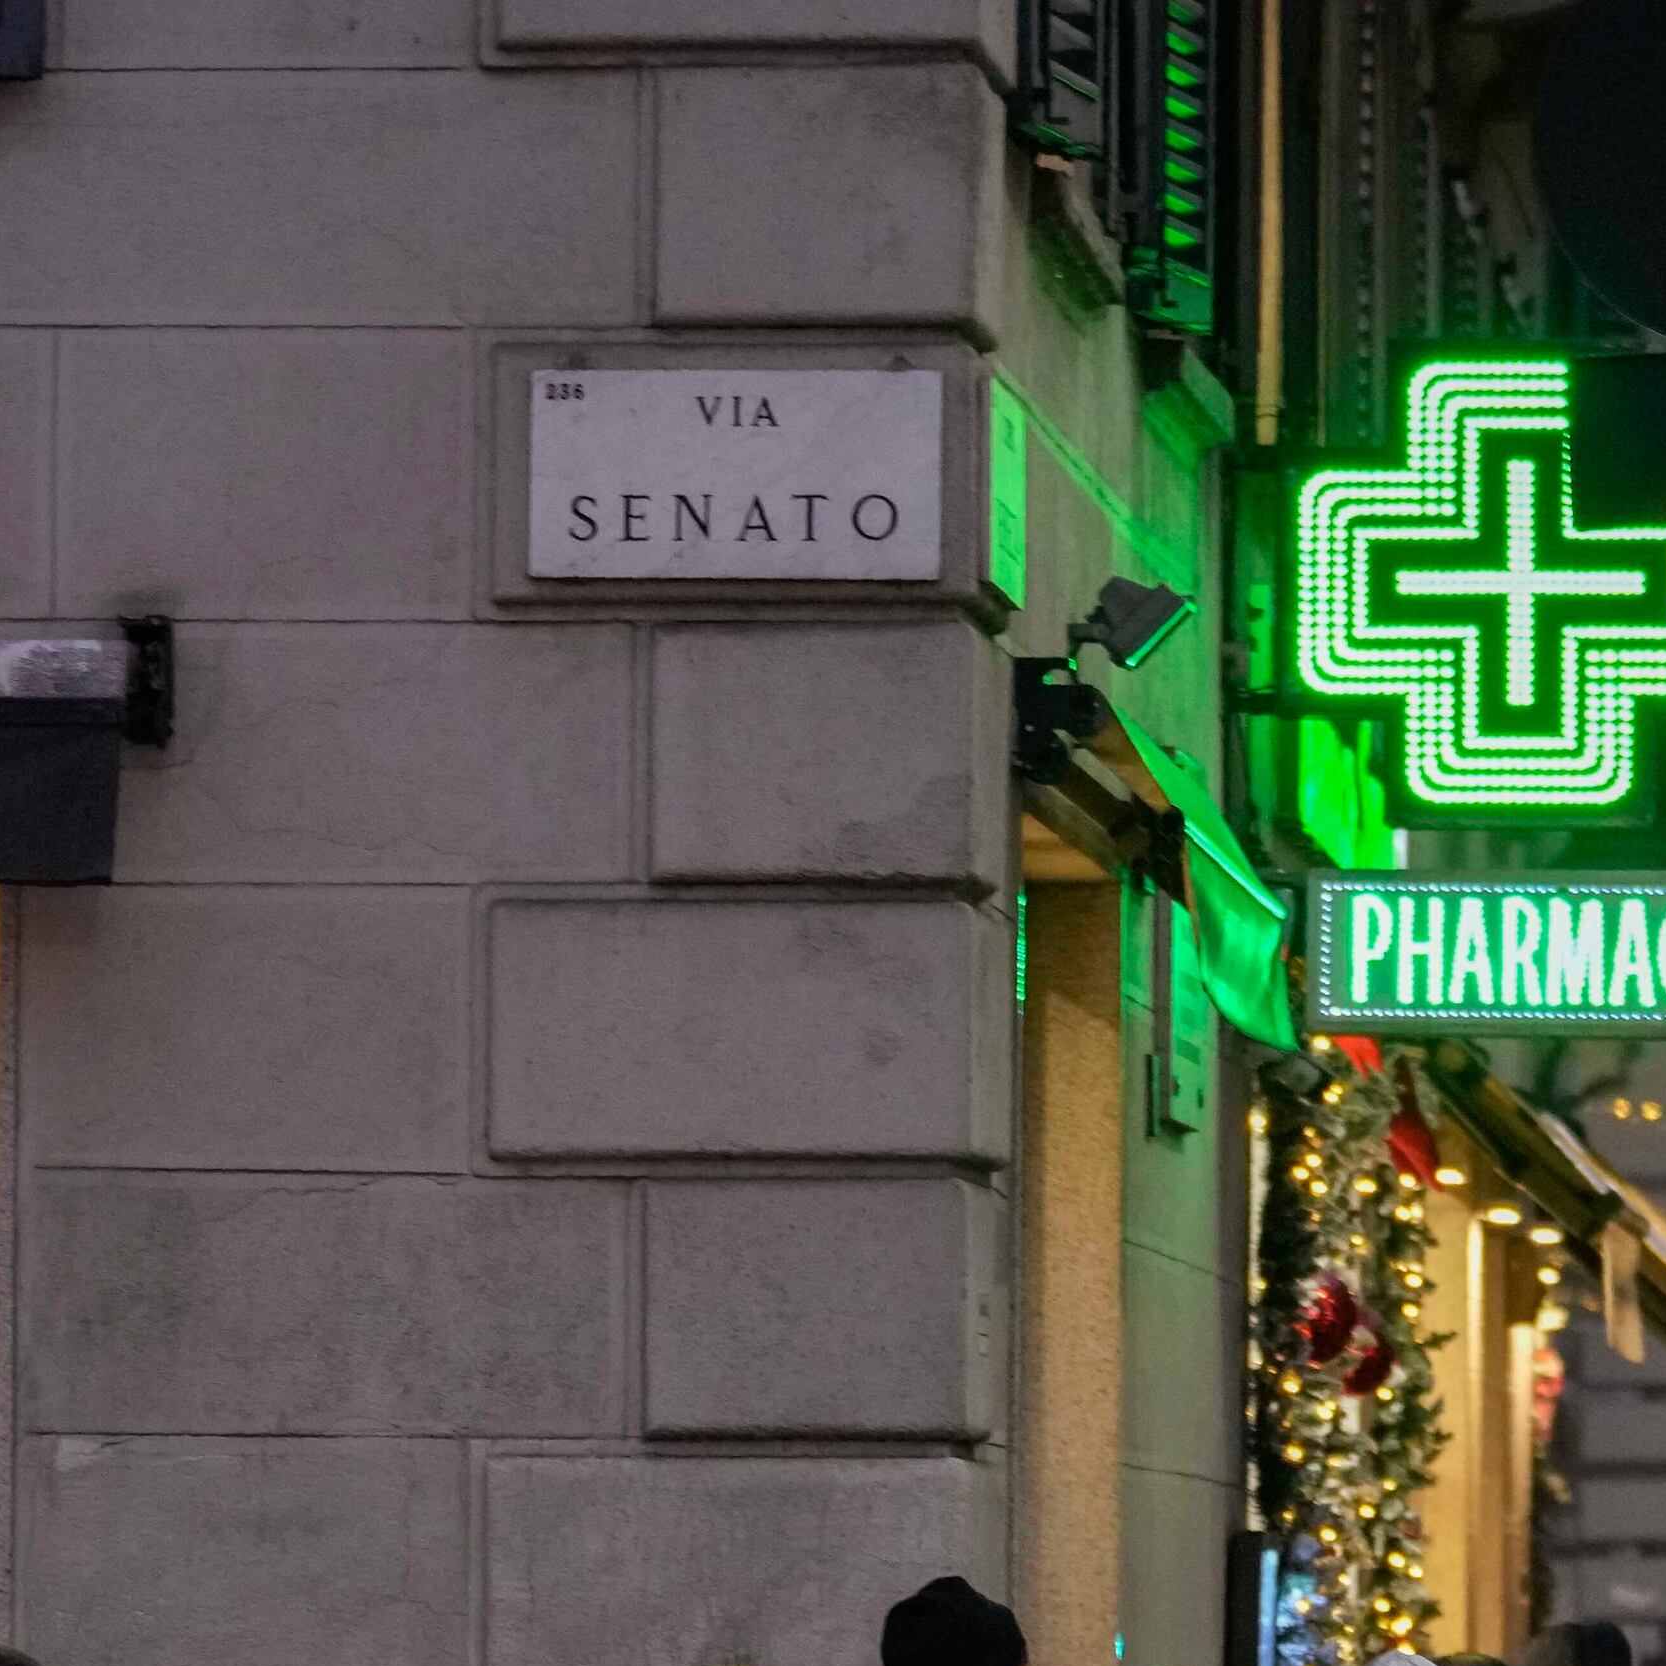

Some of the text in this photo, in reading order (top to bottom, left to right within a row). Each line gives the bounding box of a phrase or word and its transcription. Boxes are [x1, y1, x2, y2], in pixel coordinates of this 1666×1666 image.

[545, 383, 585, 400] 236
[695, 396, 779, 427] VIA
[568, 493, 898, 542] SENATO
